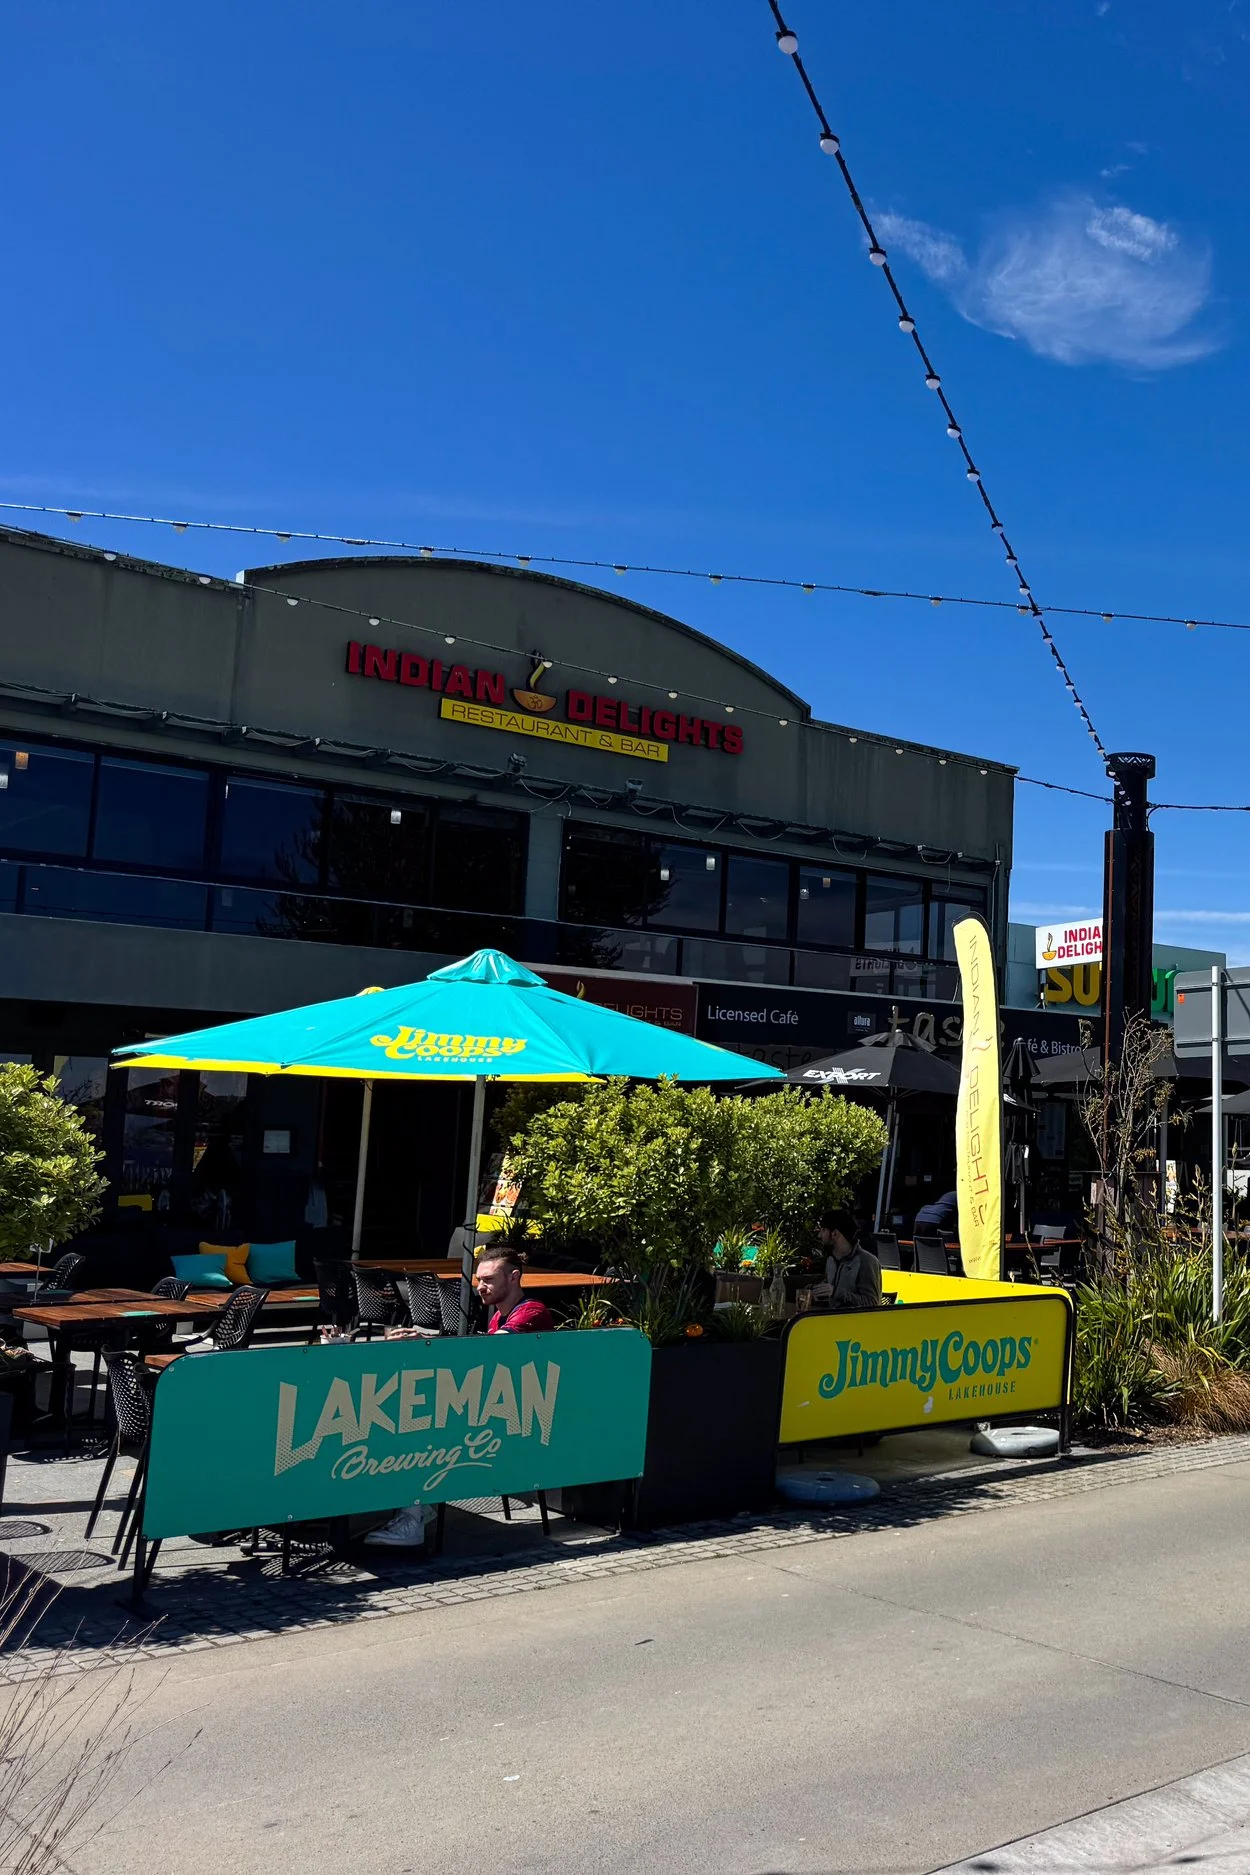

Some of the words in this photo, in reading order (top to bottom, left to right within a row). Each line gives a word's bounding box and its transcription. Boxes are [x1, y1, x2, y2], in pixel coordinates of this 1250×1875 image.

[346, 640, 505, 704] INDIAN
[566, 688, 743, 754] DELIGHTS
[451, 704, 592, 745] RESTAURANT
[599, 734, 614, 749] &
[621, 739, 660, 757] BAR
[1064, 925, 1101, 943] INDIA
[1057, 940, 1103, 959] DELIGH
[707, 1005, 767, 1023] Licensed
[770, 1009, 799, 1025] Café
[888, 1005, 1005, 1048] tas
[1040, 1042, 1049, 1053] &
[1051, 1042, 1082, 1054] Bistro
[369, 1025, 529, 1054] Jimmy
[384, 1044, 503, 1060] Coops
[948, 1380, 1017, 1401] LAKEHOUSE
[274, 1360, 561, 1477] LAKEMAN
[331, 1444, 480, 1491] Brewing
